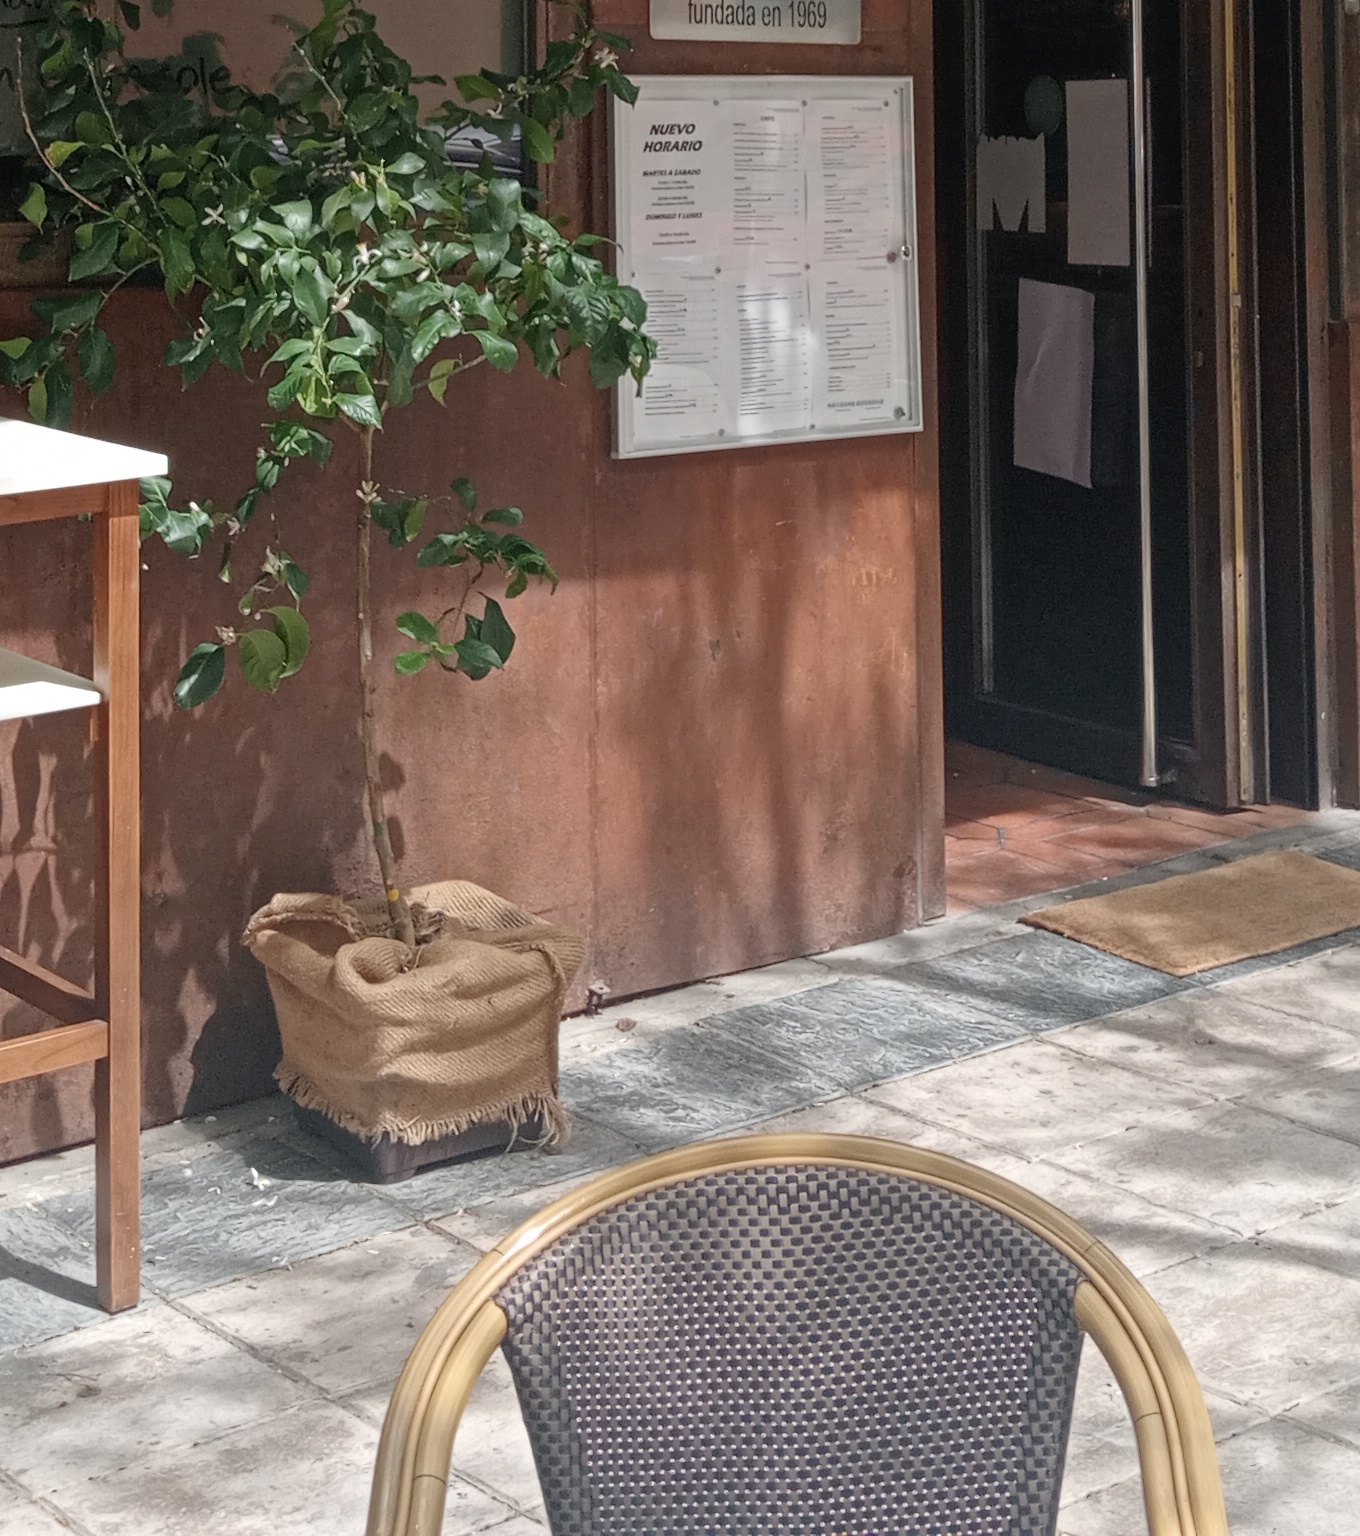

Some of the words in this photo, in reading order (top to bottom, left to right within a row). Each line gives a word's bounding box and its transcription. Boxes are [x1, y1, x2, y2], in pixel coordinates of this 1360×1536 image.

[761, 4, 784, 27] en
[649, 123, 697, 136] NUEVO
[642, 140, 703, 153] HORARIO
